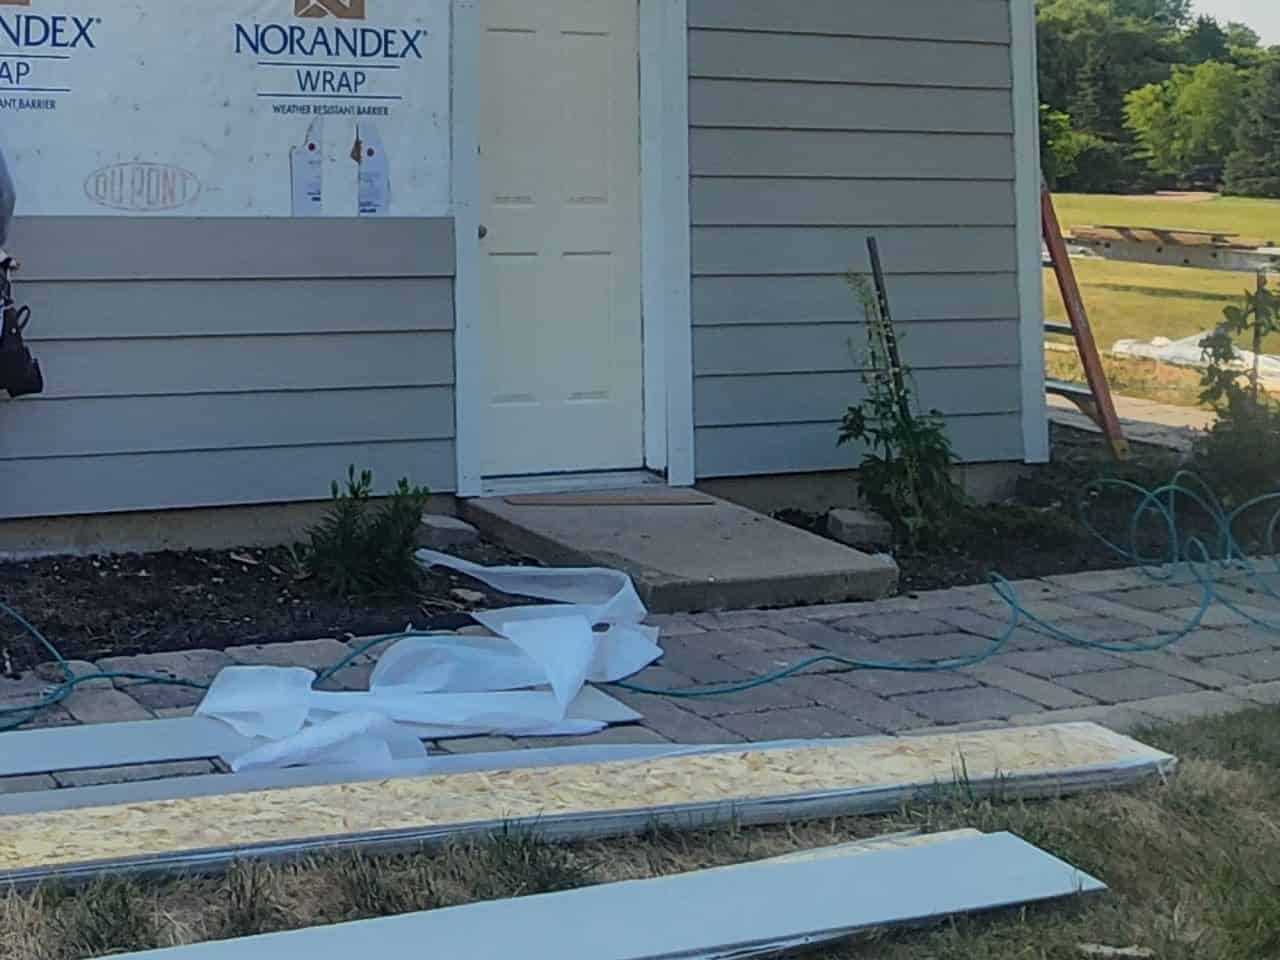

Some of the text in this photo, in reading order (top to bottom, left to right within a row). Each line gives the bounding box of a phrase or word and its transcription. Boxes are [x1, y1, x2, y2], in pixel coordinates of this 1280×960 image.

[234, 23, 423, 59] NORANDEX
[296, 69, 367, 93] WRAP
[19, 98, 57, 111] BARRIER
[272, 103, 311, 115] WEATHER
[313, 104, 355, 116] RESISTANT
